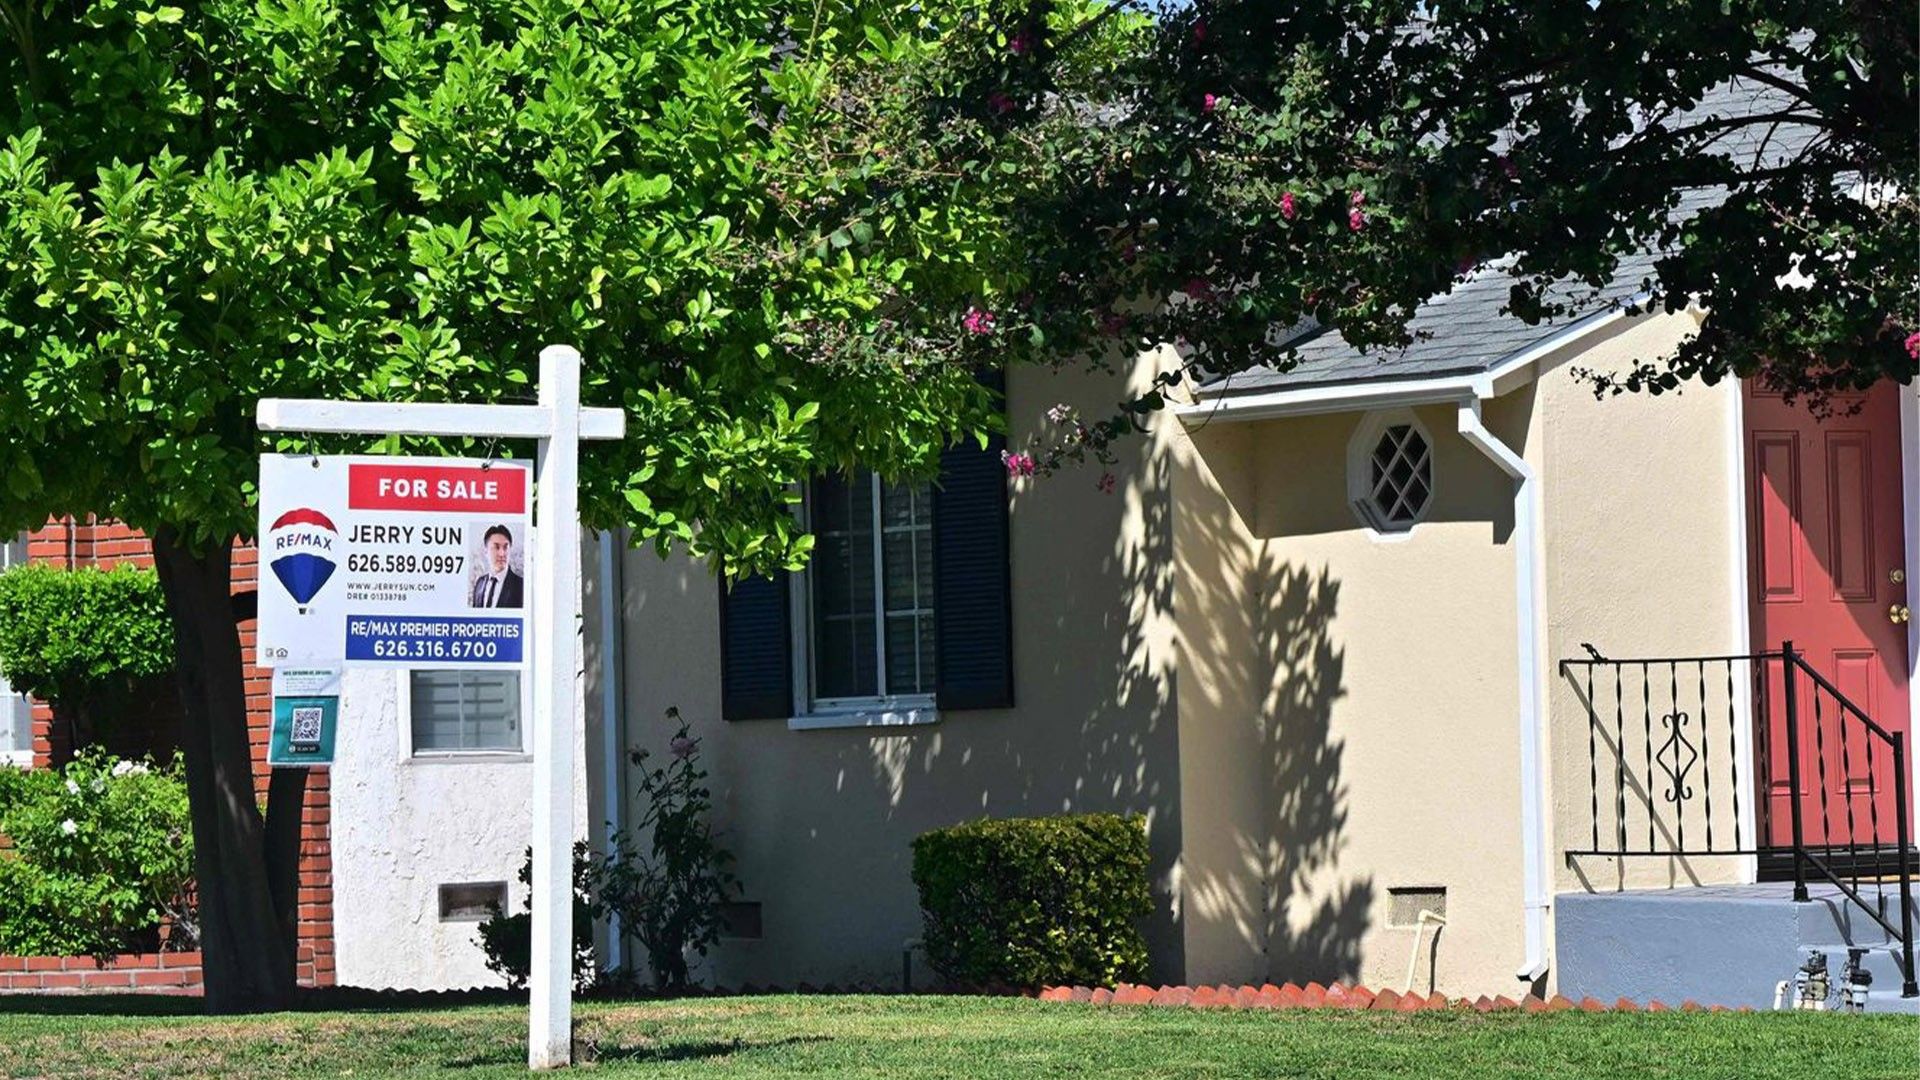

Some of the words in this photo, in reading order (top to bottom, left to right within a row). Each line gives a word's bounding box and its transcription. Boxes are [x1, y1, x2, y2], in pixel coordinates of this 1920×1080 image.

[378, 478, 428, 498] FOR
[437, 479, 498, 500] SALE
[276, 533, 332, 551] RE/MAX
[348, 525, 414, 544] JERRY
[422, 527, 462, 545] SUN
[348, 554, 464, 574] 626.589.0997
[347, 582, 435, 591] WWW.JERRYSUN.COM
[351, 620, 398, 638] RE/MAX
[400, 622, 450, 637] PREMIER
[452, 623, 519, 638] PROPERTIES
[374, 640, 497, 658] 626.316.6700
